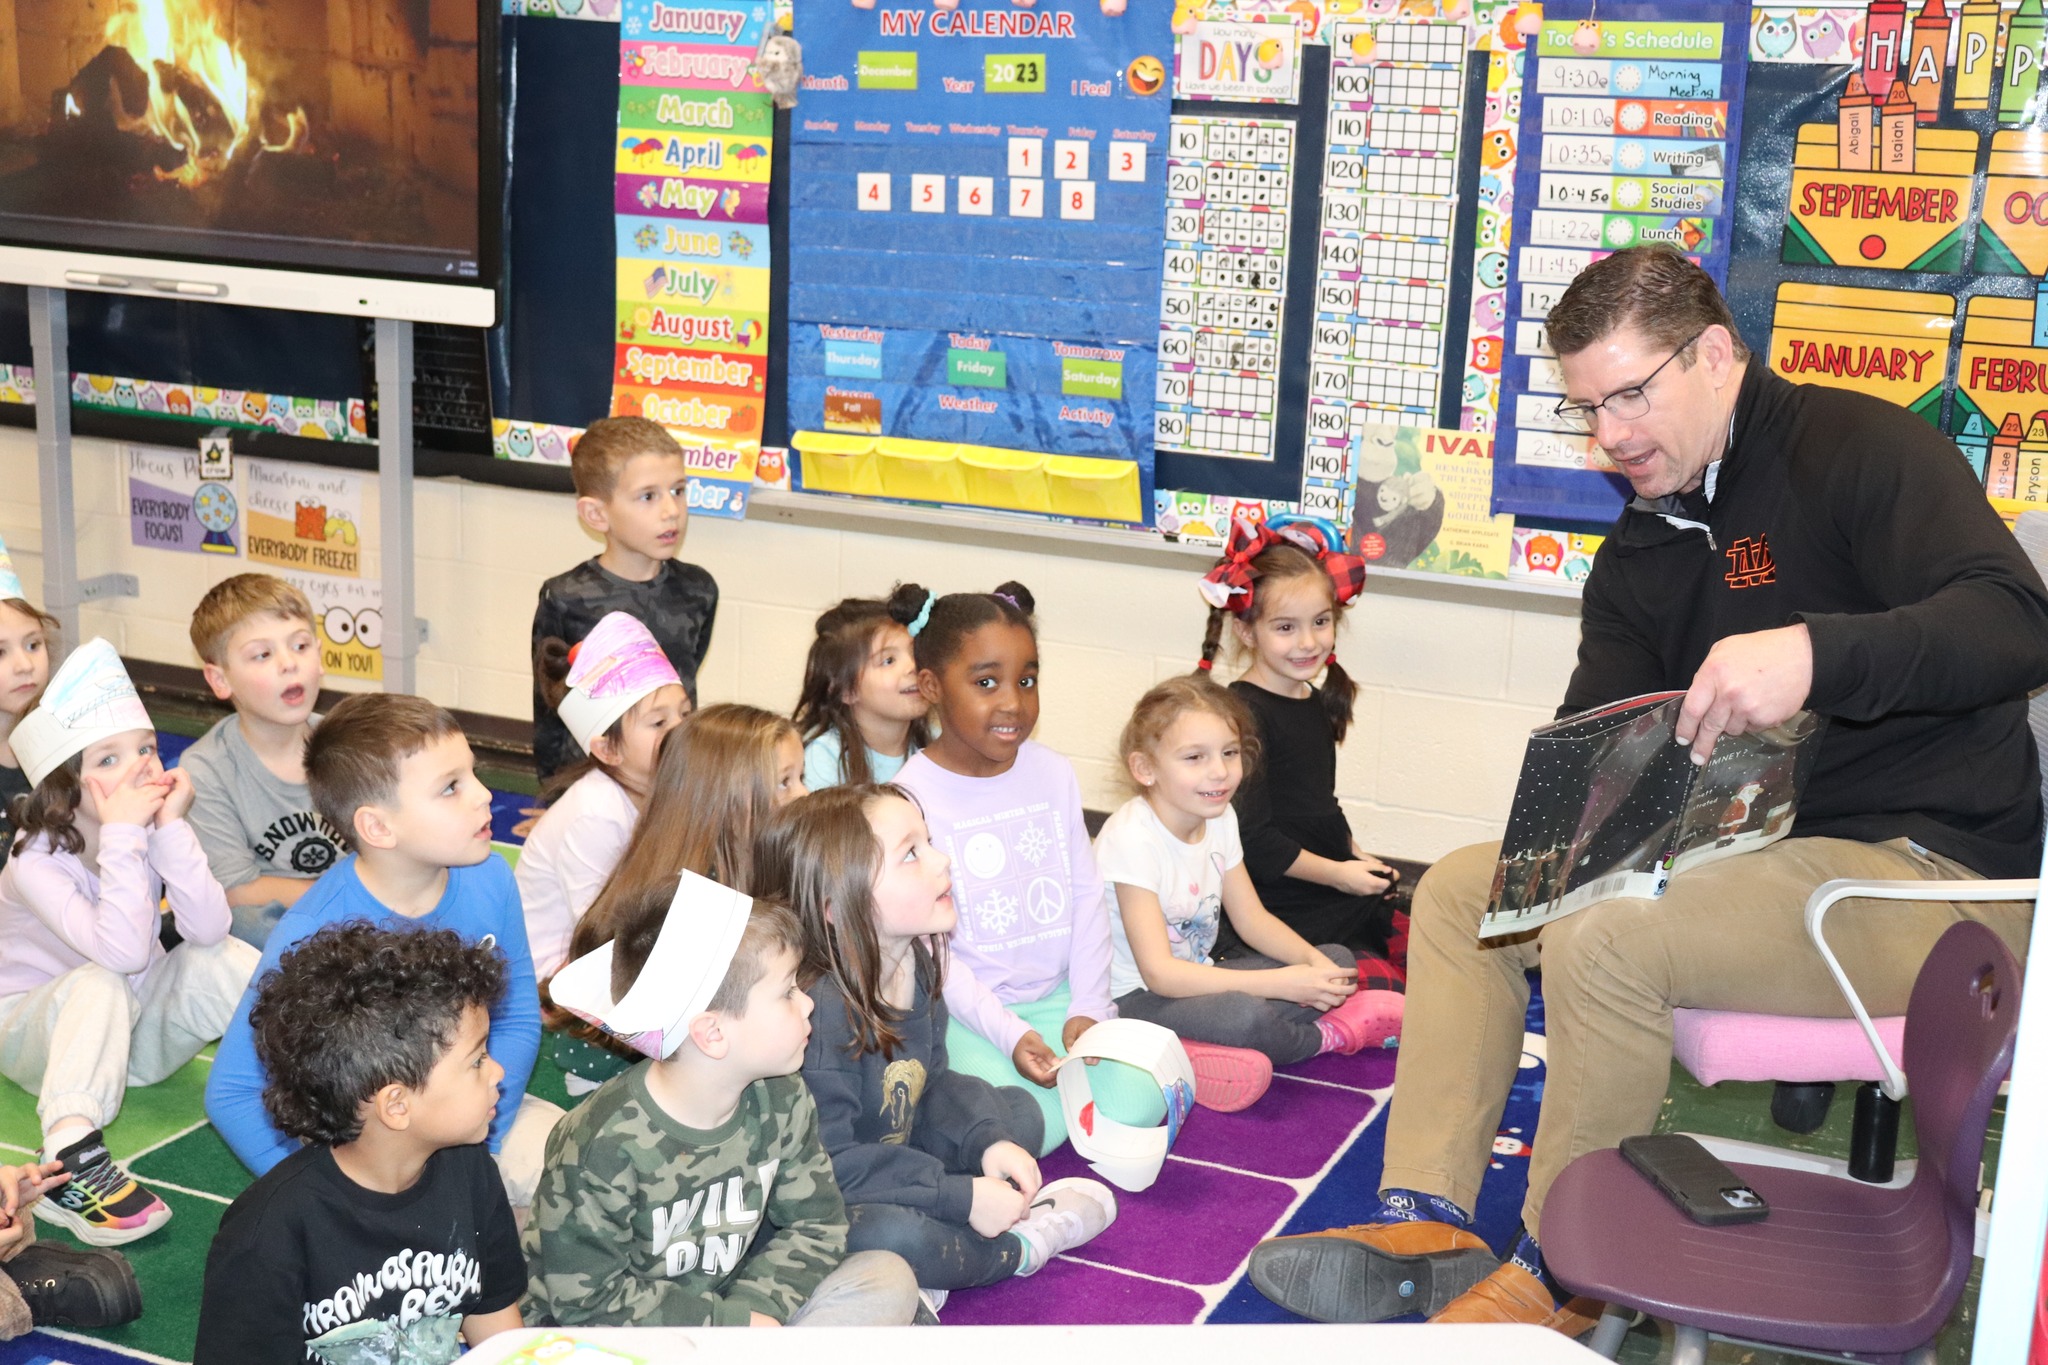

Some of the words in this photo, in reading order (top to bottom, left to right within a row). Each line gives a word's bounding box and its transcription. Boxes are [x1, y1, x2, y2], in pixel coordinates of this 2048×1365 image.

[650, 5, 746, 41] January
[881, 10, 925, 35] MY
[930, 11, 1075, 38] CALENDAR
[1546, 30, 1617, 49] To's
[1624, 31, 1713, 49] Schedule
[642, 45, 749, 87] February
[859, 65, 913, 77] December
[991, 62, 1039, 84] 2023
[801, 75, 848, 91] Month
[943, 77, 975, 94] Year
[1071, 81, 1077, 95] I
[1080, 82, 1112, 98] Feel
[1336, 75, 1369, 94] 100
[1892, 90, 1905, 99] 20
[657, 94, 733, 128] March
[1653, 111, 1713, 129] Reading
[1338, 119, 1362, 137] 110
[1849, 112, 1859, 155] Abigail
[1179, 133, 1197, 150] 10
[1891, 120, 1904, 163] Isaiah
[664, 138, 722, 172] April
[1021, 148, 1029, 166] 1
[1066, 152, 1077, 170] 2
[1121, 153, 1133, 171] 3
[1653, 152, 1704, 166] Writing
[1331, 160, 1362, 179] 120
[1173, 174, 1199, 192] 20
[1652, 182, 1694, 195] Social
[659, 178, 717, 217] May
[868, 184, 879, 201] 4
[923, 185, 933, 202] 5
[969, 187, 981, 205] 6
[1021, 189, 1031, 206] 7
[1071, 192, 1083, 210] 8
[1650, 197, 1702, 210] Studies
[1799, 182, 1958, 223] SEPTEMBER
[1328, 203, 1359, 222] 130
[1172, 216, 1197, 234] 30
[1641, 227, 1682, 241] Lunch
[663, 225, 721, 258] June
[1323, 244, 1358, 263] 140
[1168, 256, 1195, 274] 40
[666, 268, 716, 303] July
[1321, 287, 1352, 305] 150
[1165, 298, 1191, 316] 50
[651, 310, 733, 344] August
[819, 324, 884, 343] Yesterday
[949, 333, 991, 351] Today
[1318, 327, 1349, 347] 160
[1052, 341, 1125, 361] Tomorrow
[1162, 338, 1188, 356] 60
[627, 347, 752, 386] September
[826, 351, 880, 368] Thursday
[957, 360, 995, 377] Friday
[1780, 340, 1934, 382] JANUARY
[1063, 369, 1120, 388] Saturday
[1163, 378, 1186, 396] 70
[1315, 371, 1347, 391] 170
[643, 394, 731, 429] October
[938, 395, 998, 414] Weather
[1059, 406, 1114, 427] Activity
[1159, 417, 1183, 435] 80
[1312, 412, 1343, 430] 180
[1971, 422, 1978, 431] 2
[2006, 423, 2019, 432] 22
[2031, 428, 2045, 437] 23
[684, 446, 738, 472] mber
[1309, 456, 1340, 475] 190
[2025, 457, 2042, 502] Bryson
[132, 497, 191, 521] EVERYBODY
[1304, 489, 1340, 510] 200
[144, 521, 183, 543] FOCUS!
[247, 536, 308, 563] EVERYBODY
[312, 547, 358, 572] FREEZE!
[325, 650, 342, 669] ON
[347, 653, 373, 674] YOU!
[1707, 748, 1748, 767] IMNEY?
